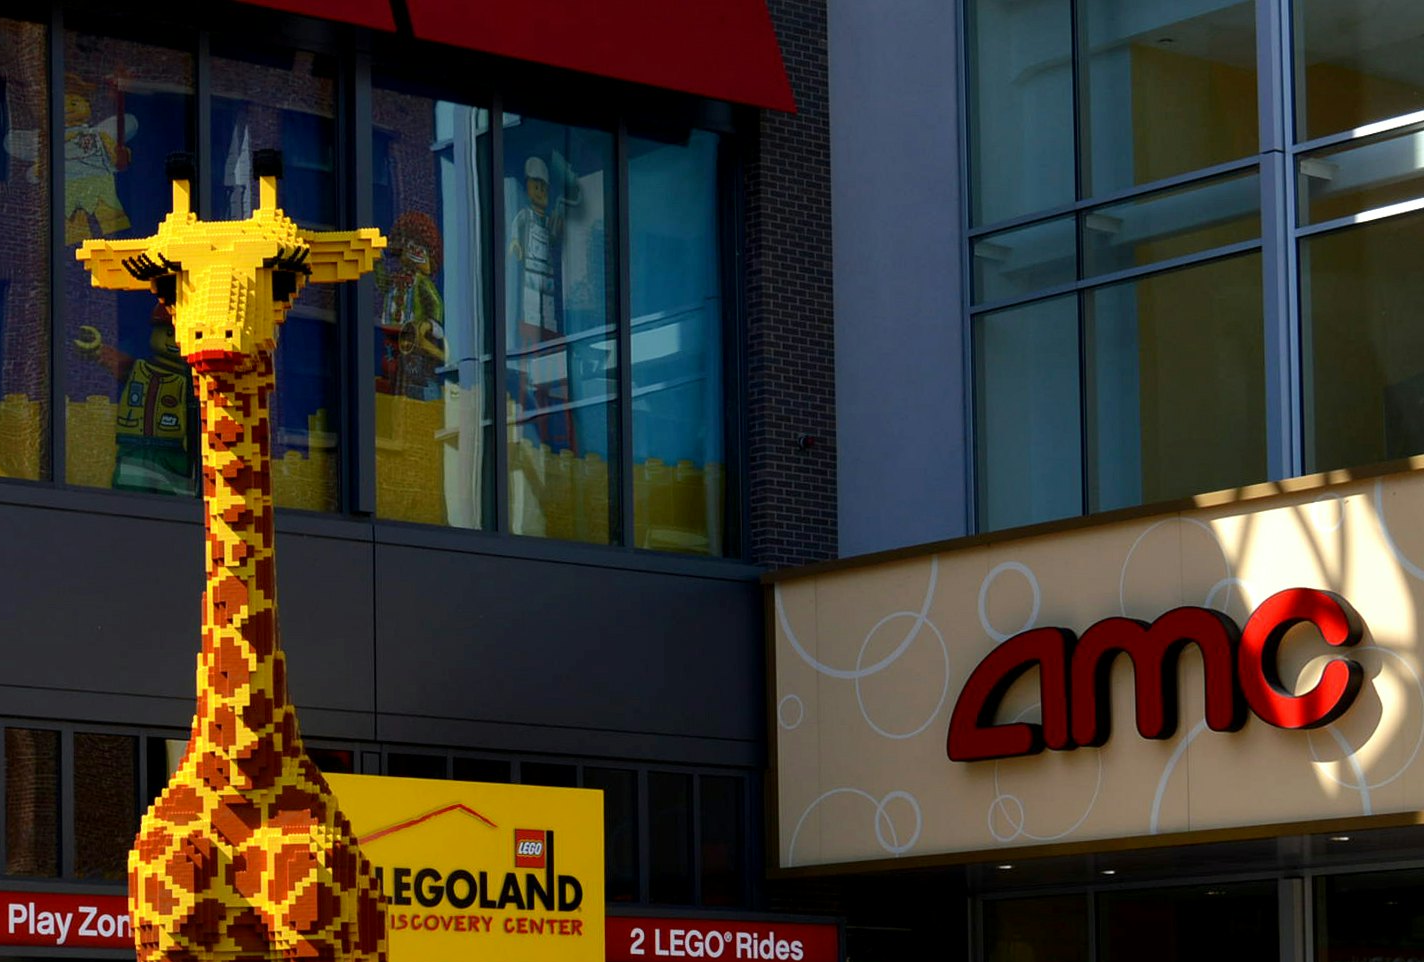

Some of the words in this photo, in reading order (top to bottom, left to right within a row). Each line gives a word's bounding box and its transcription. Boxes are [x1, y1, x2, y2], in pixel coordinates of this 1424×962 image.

[518, 841, 542, 855] LEGO
[8, 902, 73, 945] Play
[78, 906, 133, 938] Zon
[391, 914, 493, 932] ISCOVERY
[503, 918, 583, 935] CENTER
[630, 928, 645, 955] 2
[736, 931, 804, 961] Rides
